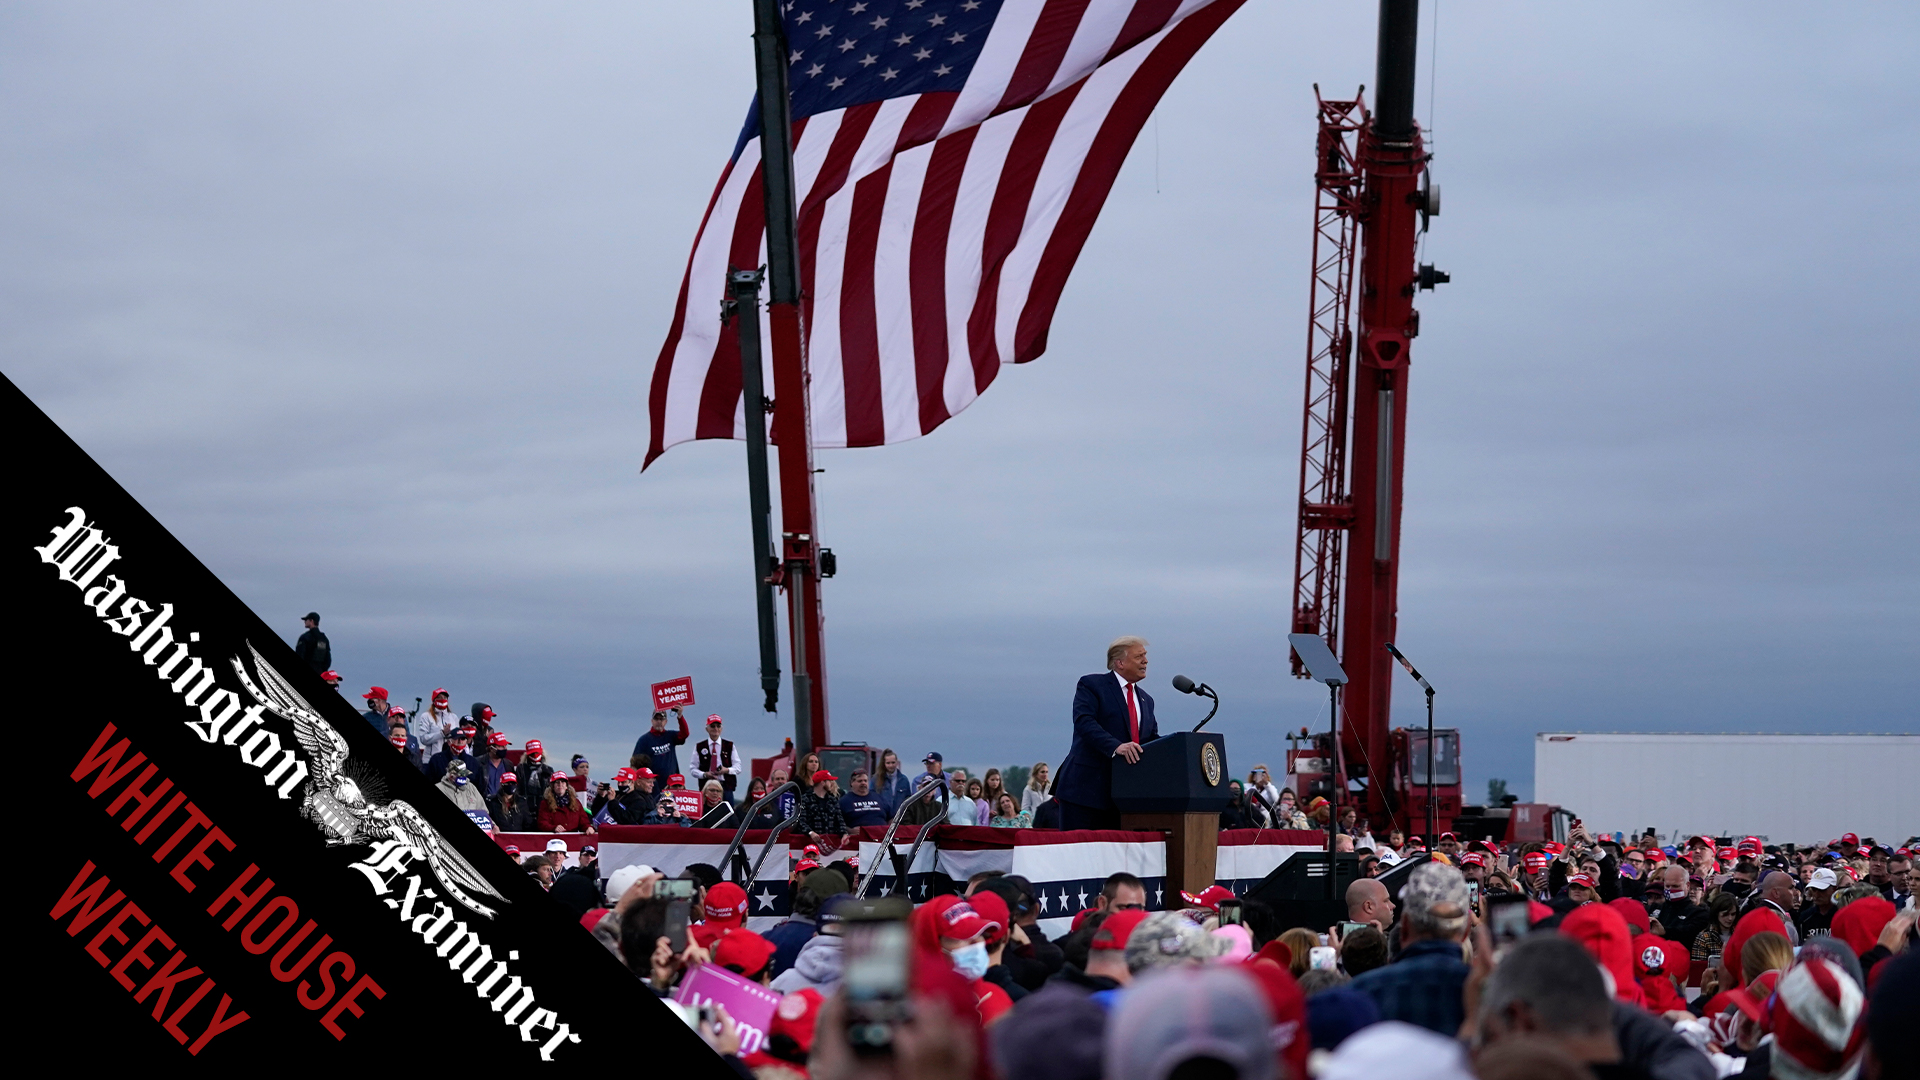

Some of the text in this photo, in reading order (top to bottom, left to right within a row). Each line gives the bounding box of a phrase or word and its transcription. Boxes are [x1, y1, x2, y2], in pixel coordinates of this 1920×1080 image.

[664, 684, 687, 695] MORE
[659, 692, 688, 704] YEARS!
[675, 796, 698, 804] MORE
[676, 804, 698, 813] EARS!
[783, 798, 791, 820] YEAR
